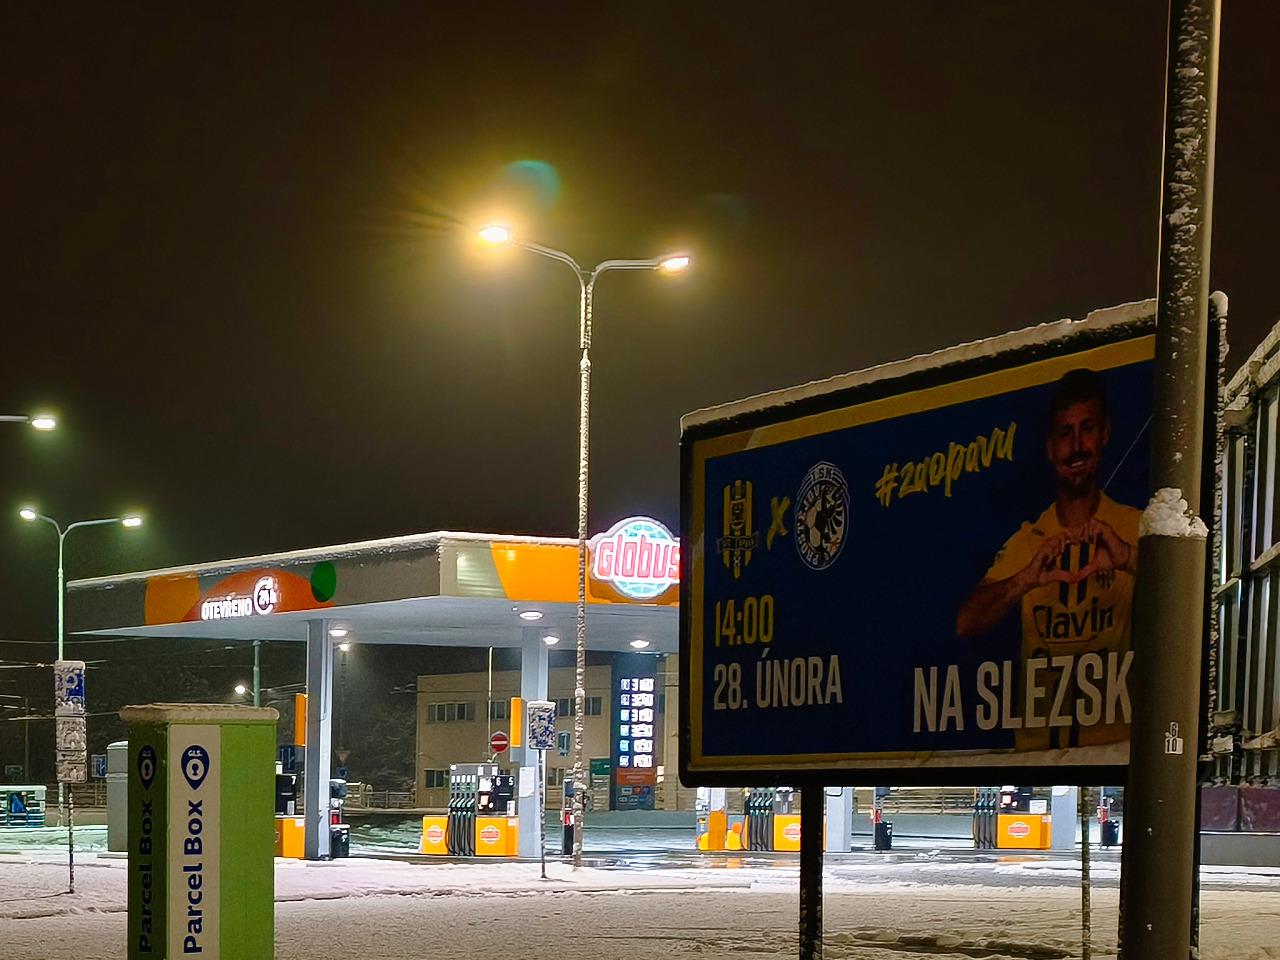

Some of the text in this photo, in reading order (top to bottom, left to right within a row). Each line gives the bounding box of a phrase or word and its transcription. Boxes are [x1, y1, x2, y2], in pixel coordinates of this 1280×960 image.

[597, 534, 681, 579] Globus
[714, 593, 775, 648] 14:00
[1032, 597, 1116, 640] Clavin
[713, 647, 844, 711] 28. ÚNORA
[912, 650, 1135, 734] NA SLEZSK
[139, 800, 152, 953] Parcel Box
[183, 800, 203, 954] Parcel Box
